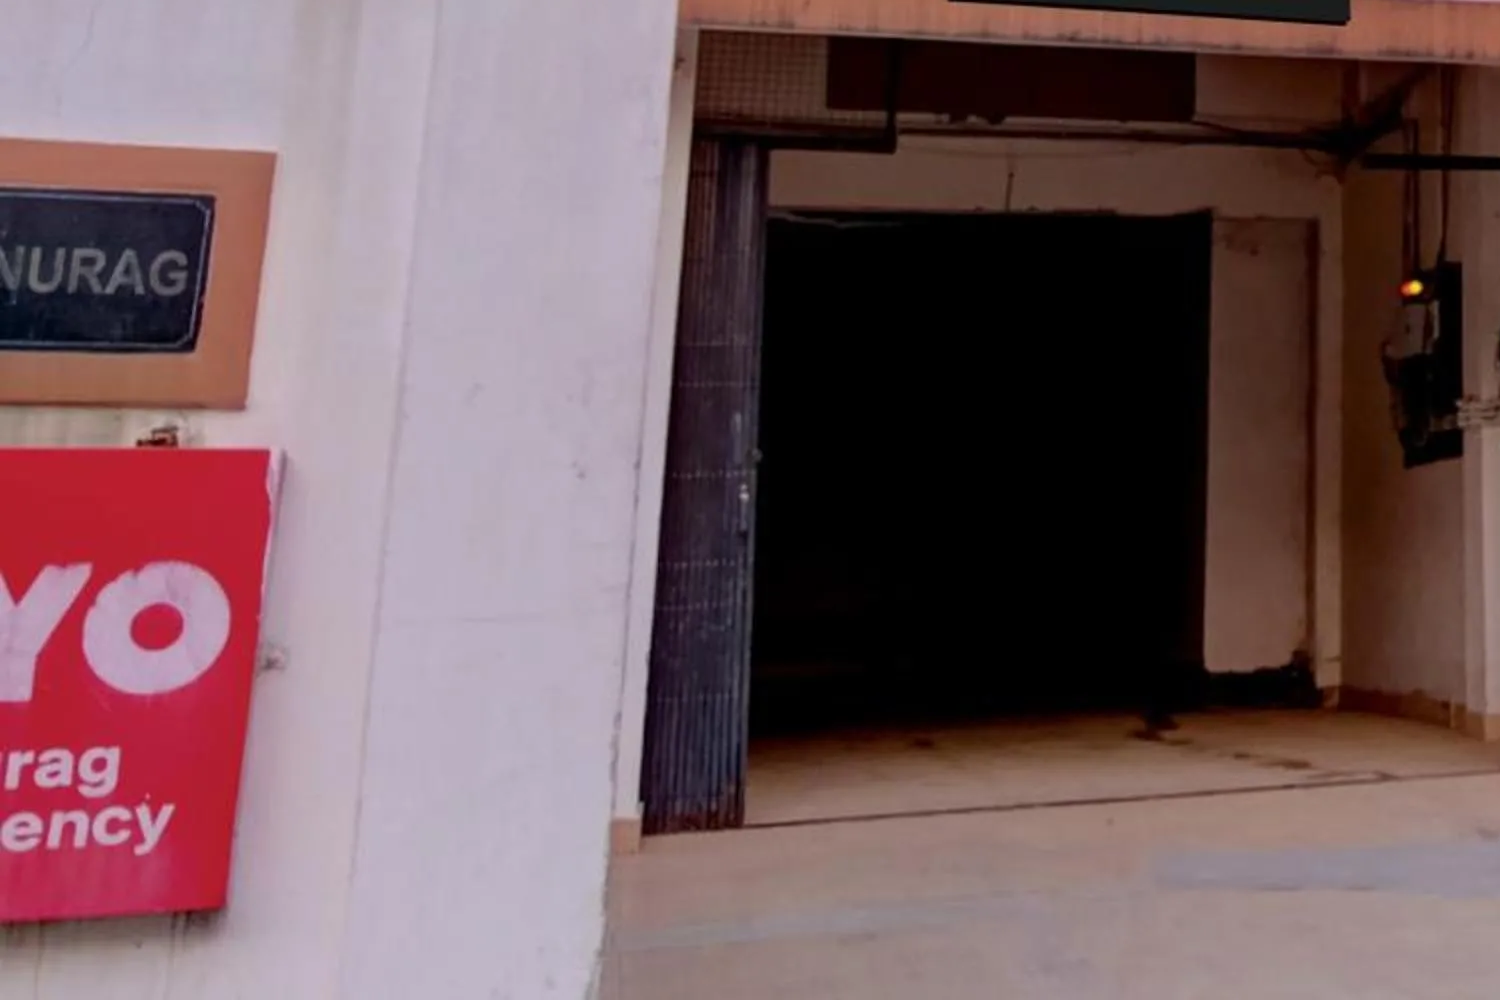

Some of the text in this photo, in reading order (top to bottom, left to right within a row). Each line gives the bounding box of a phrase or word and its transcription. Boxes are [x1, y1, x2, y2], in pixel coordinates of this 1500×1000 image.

[0, 560, 231, 702] YO
[0, 745, 121, 798] rag
[0, 802, 176, 856] ency
